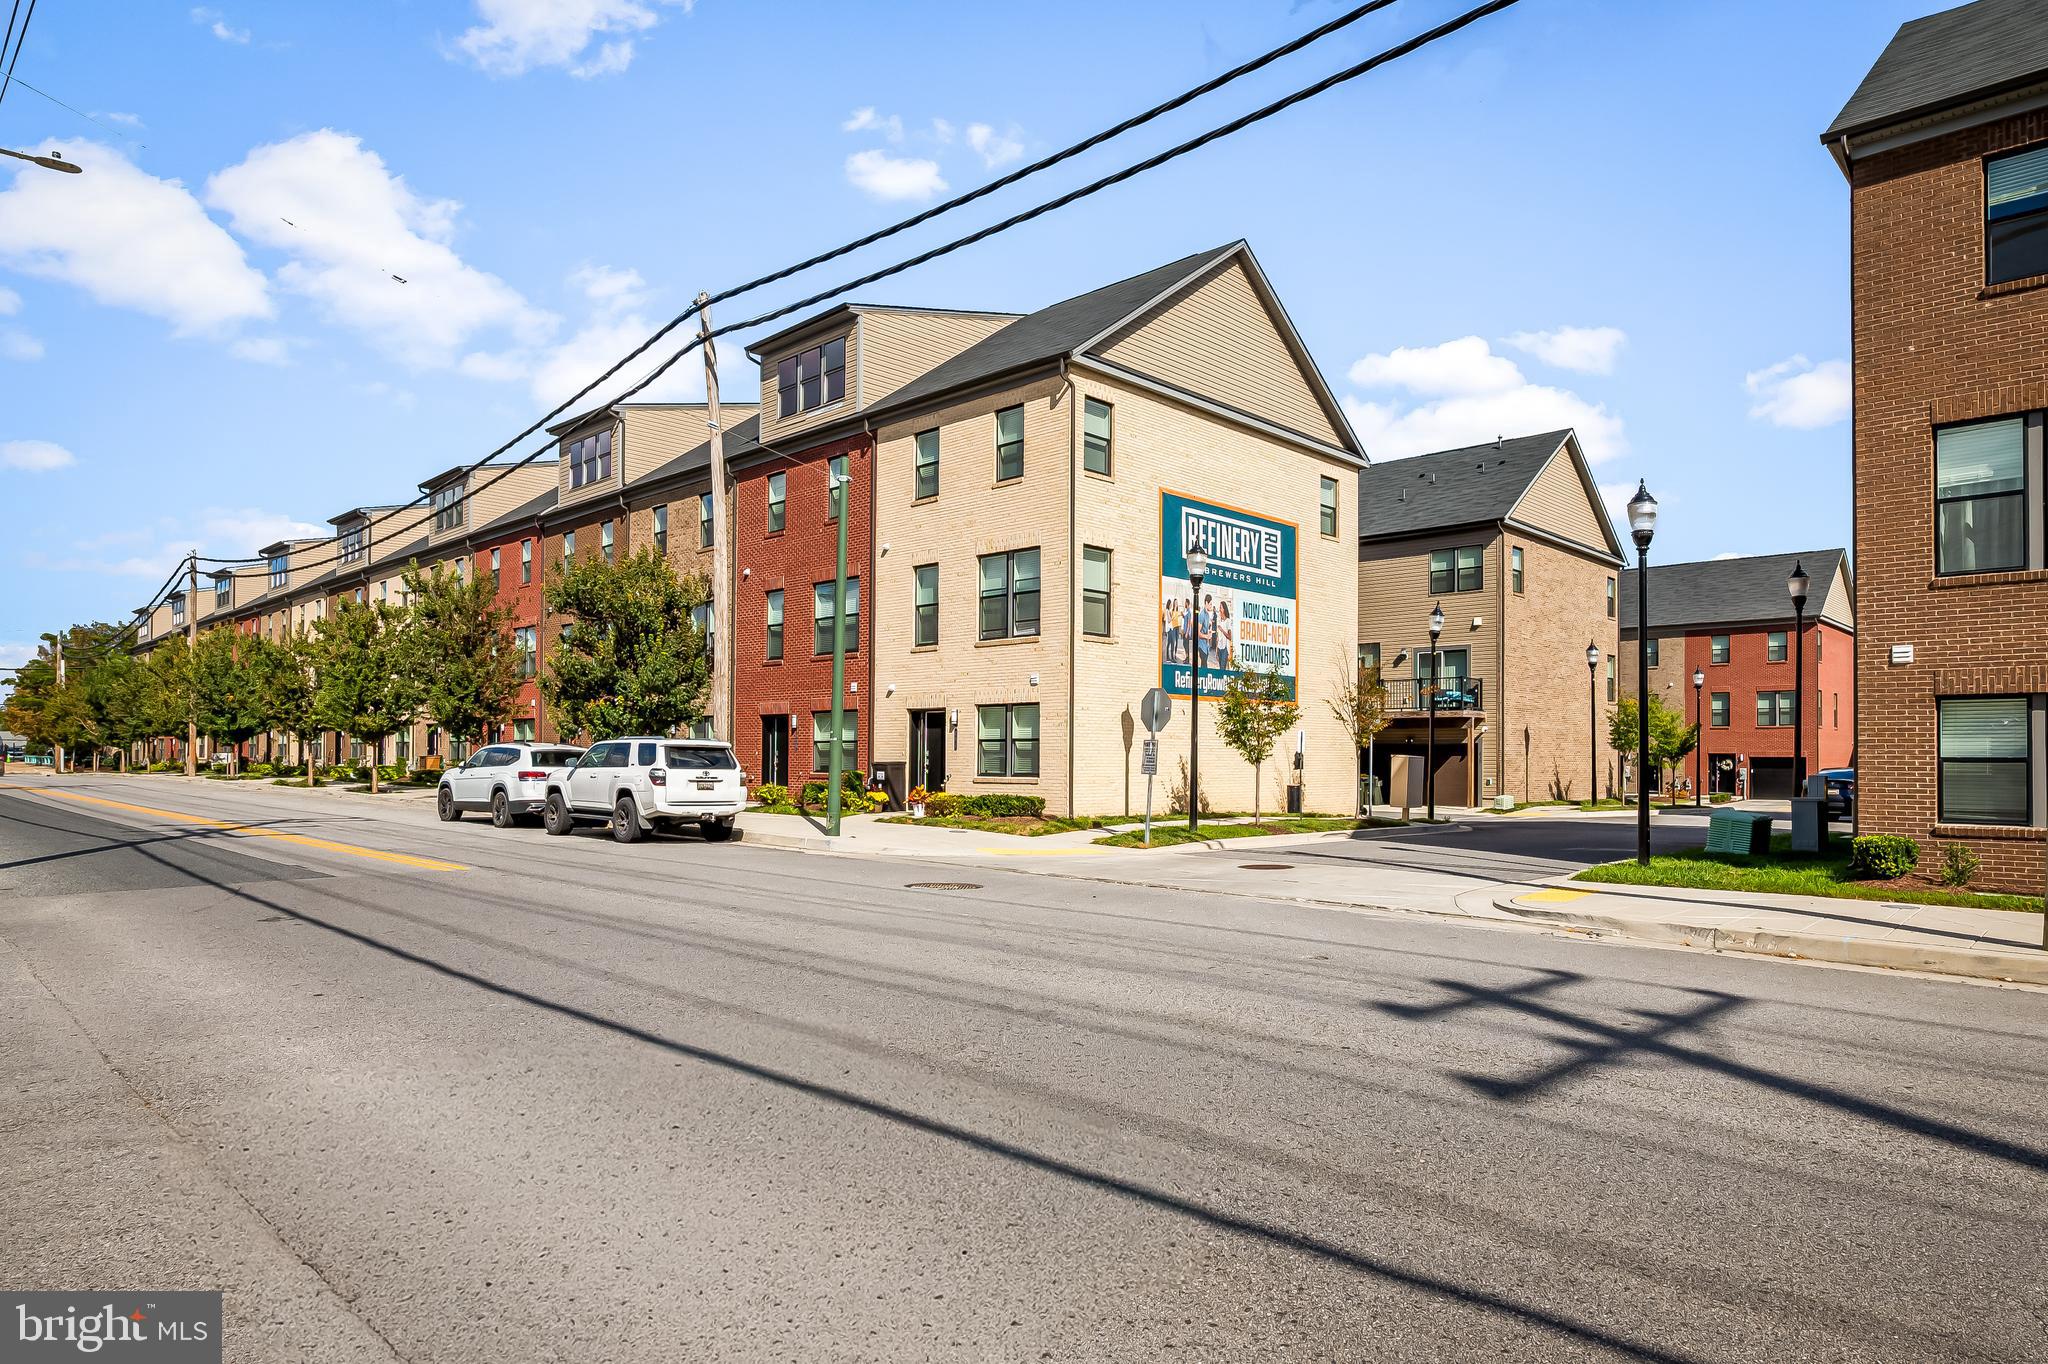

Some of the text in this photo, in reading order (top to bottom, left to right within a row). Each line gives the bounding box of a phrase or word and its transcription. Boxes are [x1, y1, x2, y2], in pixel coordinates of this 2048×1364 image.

[1188, 515, 1259, 565] REFINERY
[1264, 531, 1278, 573] ROW
[1204, 566, 1276, 588] BREWERS HILL
[1242, 601, 1289, 625] NOW SELLING
[1240, 620, 1290, 646] BRAND-NEW
[1240, 643, 1290, 666] TOWNHOMES
